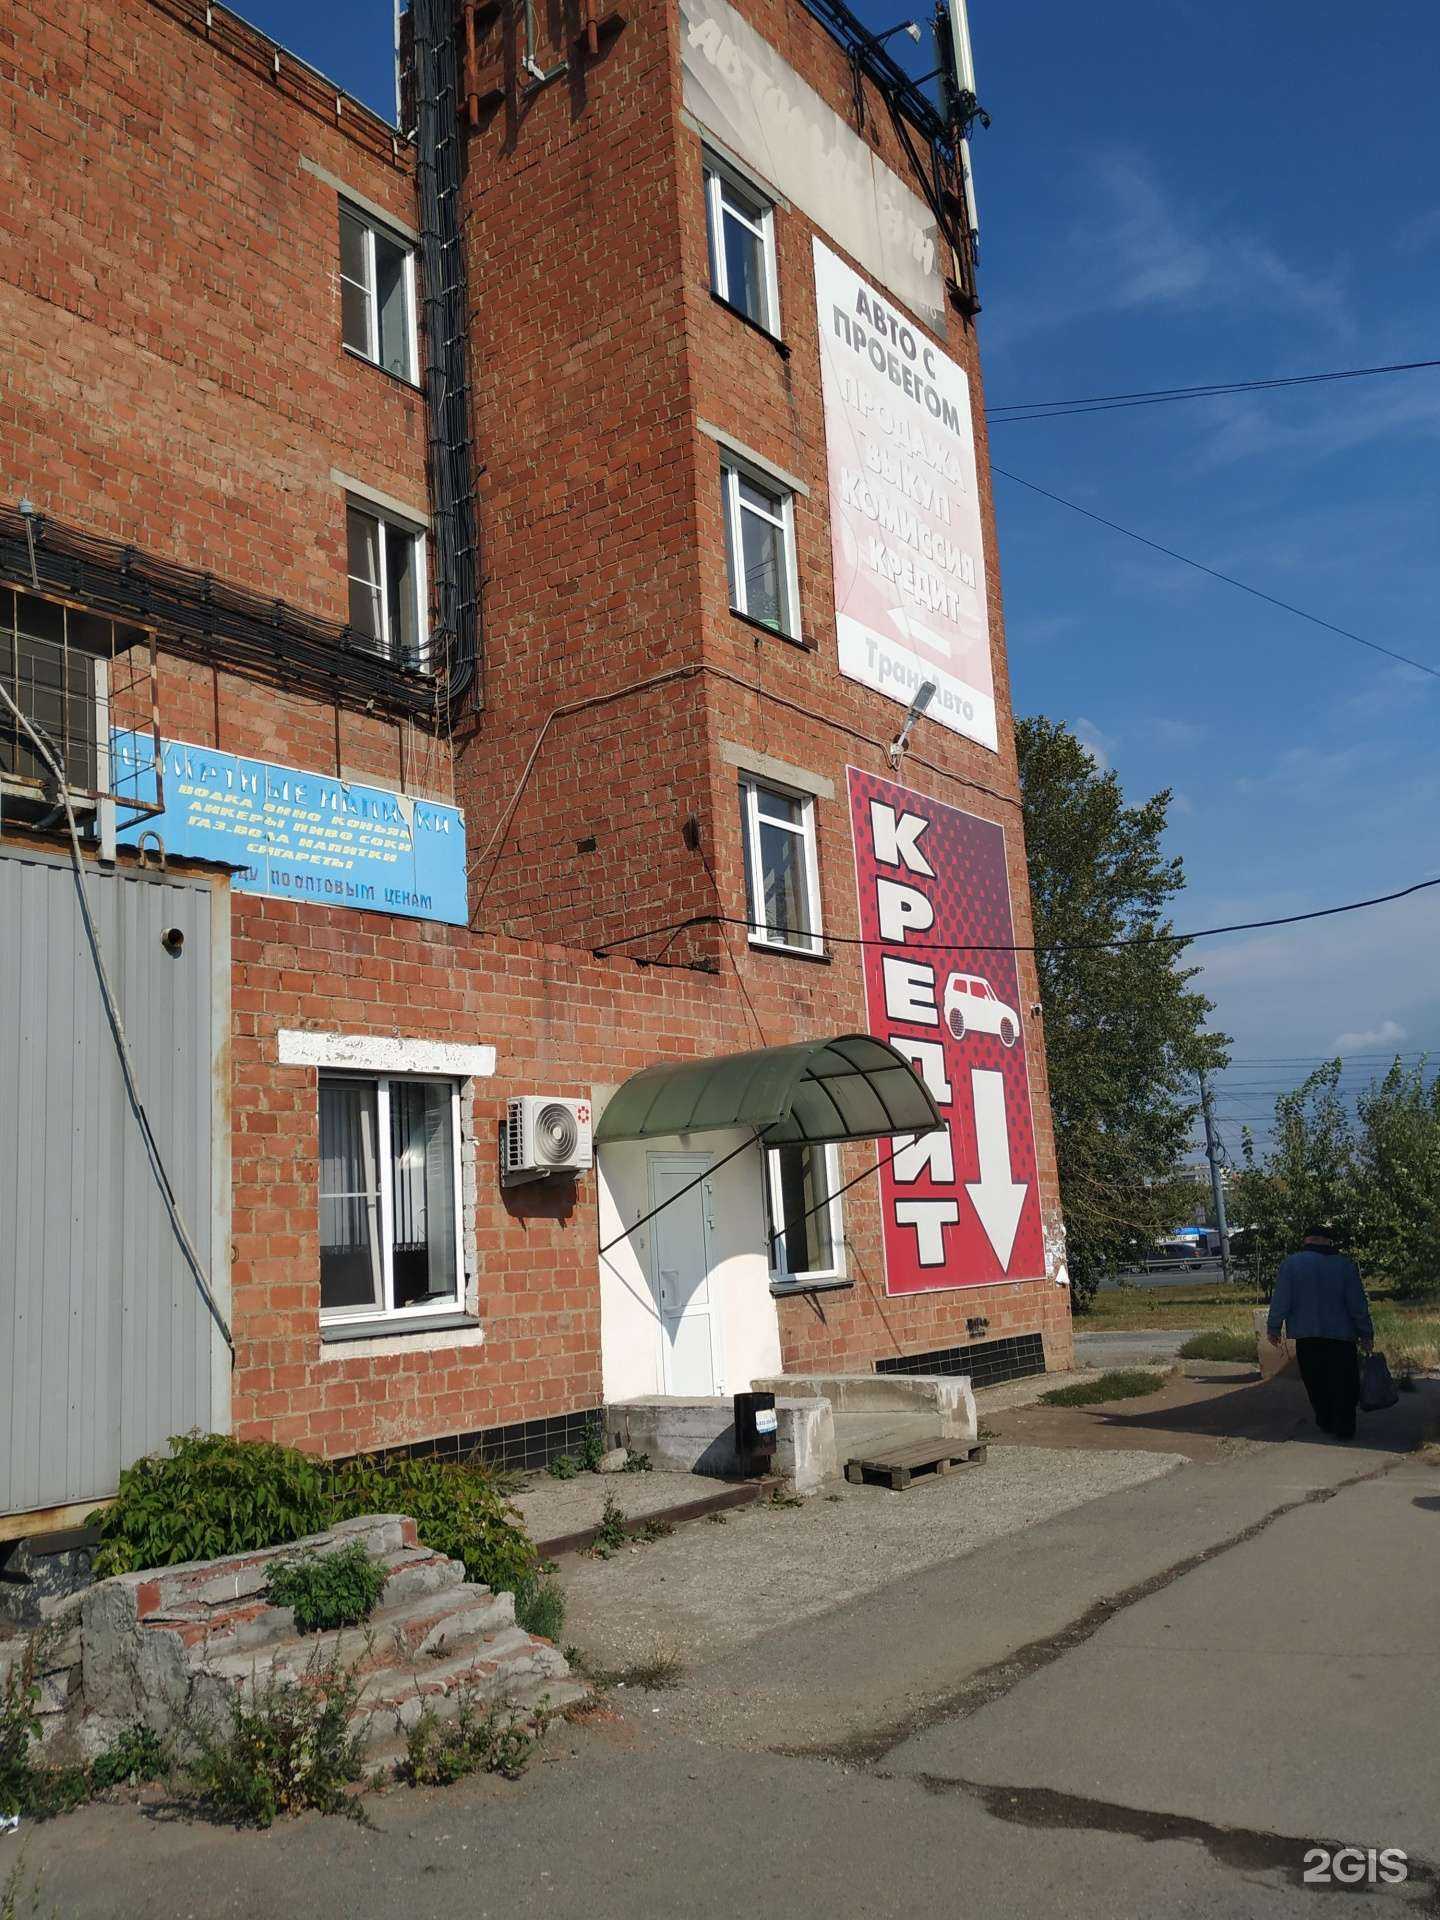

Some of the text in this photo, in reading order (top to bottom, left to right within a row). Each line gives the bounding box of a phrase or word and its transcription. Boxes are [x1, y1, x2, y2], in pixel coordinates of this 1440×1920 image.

[832, 303, 961, 437] ПРОБЕГОМ
[856, 287, 936, 380] АВТО С
[868, 536, 960, 625] КРЕДИТ
[865, 637, 974, 721] ТранАвто
[293, 822, 353, 841] ПИВО
[359, 835, 412, 853] СОКИ
[298, 838, 397, 863] НАПИТКИ
[320, 788, 449, 835] НАПИКИ
[271, 870, 290, 887] ПО
[294, 874, 375, 901] ОПТОВЫМ
[384, 887, 433, 911] ЦЕНАМ
[868, 798, 961, 1269] КРЕДИТ
